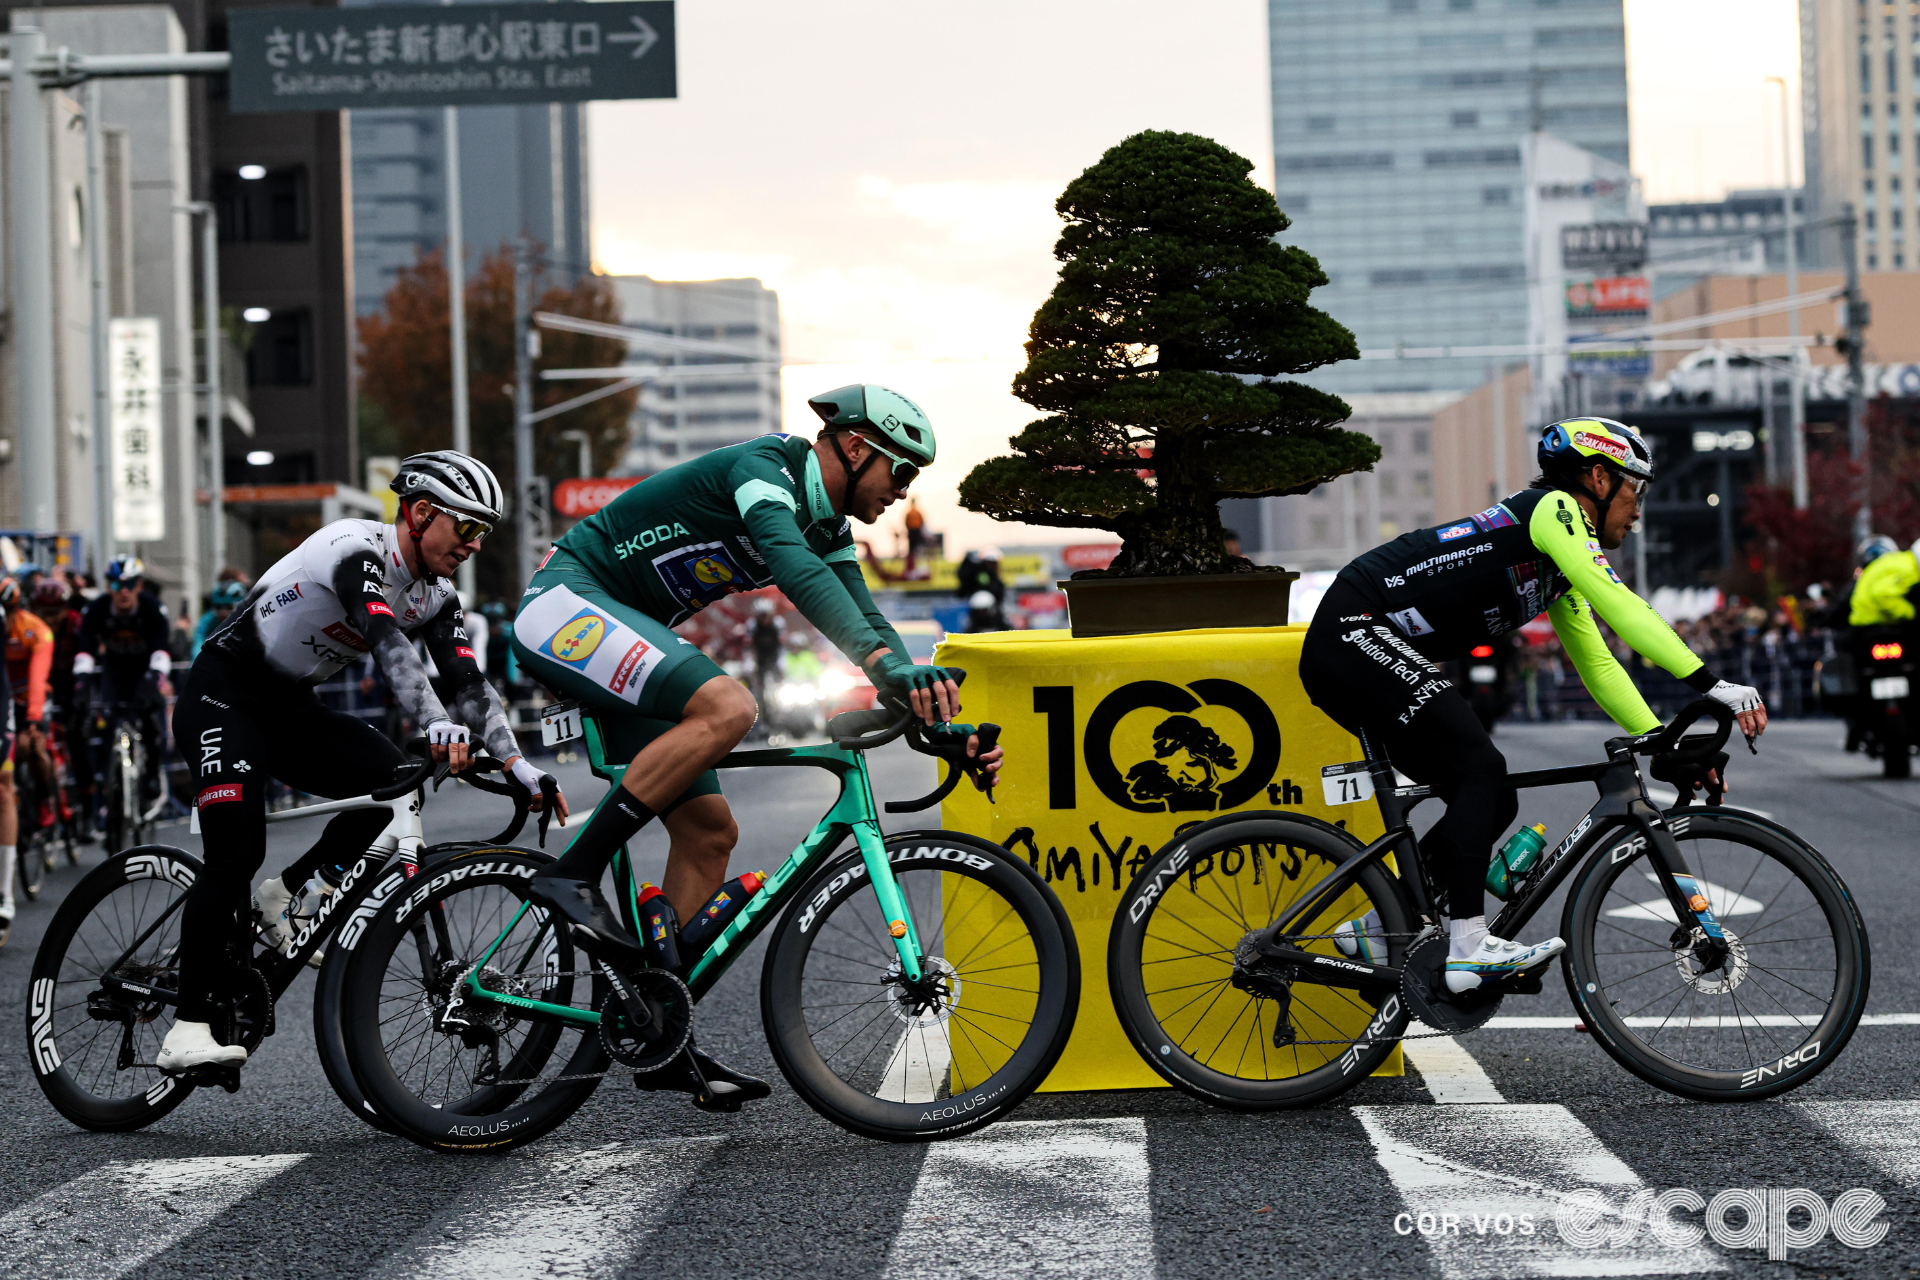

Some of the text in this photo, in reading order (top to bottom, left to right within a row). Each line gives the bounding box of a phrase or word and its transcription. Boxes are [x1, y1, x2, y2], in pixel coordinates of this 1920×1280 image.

[264, 20, 600, 67] さいたま新都心駅東口
[272, 70, 492, 95] Saitama-Shintoshin
[545, 64, 592, 88] East
[614, 522, 691, 561] ŠKODA
[1440, 527, 1473, 540] NERI
[1405, 542, 1493, 577] MULTIMARCAS
[1427, 557, 1474, 577] SPORT
[259, 601, 276, 619] IHC
[558, 620, 600, 659] LIDL
[612, 646, 645, 691] TREK
[1341, 628, 1422, 686] Solution Tech
[627, 659, 647, 689] Santini
[553, 715, 574, 742] 11
[200, 726, 223, 778] UAE
[198, 788, 237, 807] Emirates
[1337, 777, 1363, 803] 71
[1509, 848, 1530, 871] OTOREX
[395, 862, 539, 924] NTRAGER
[799, 846, 995, 934] BONTAGER
[1128, 843, 1190, 925] DRIVE
[285, 858, 367, 960] COLNAGO
[121, 982, 152, 995] SHIMANO
[493, 994, 535, 1010] SRAM
[1339, 993, 1401, 1077] DRIVE
[1740, 1040, 1822, 1090] DRIVE
[918, 1092, 987, 1124] AEOLUS
[446, 1120, 511, 1137] AEOLUS
